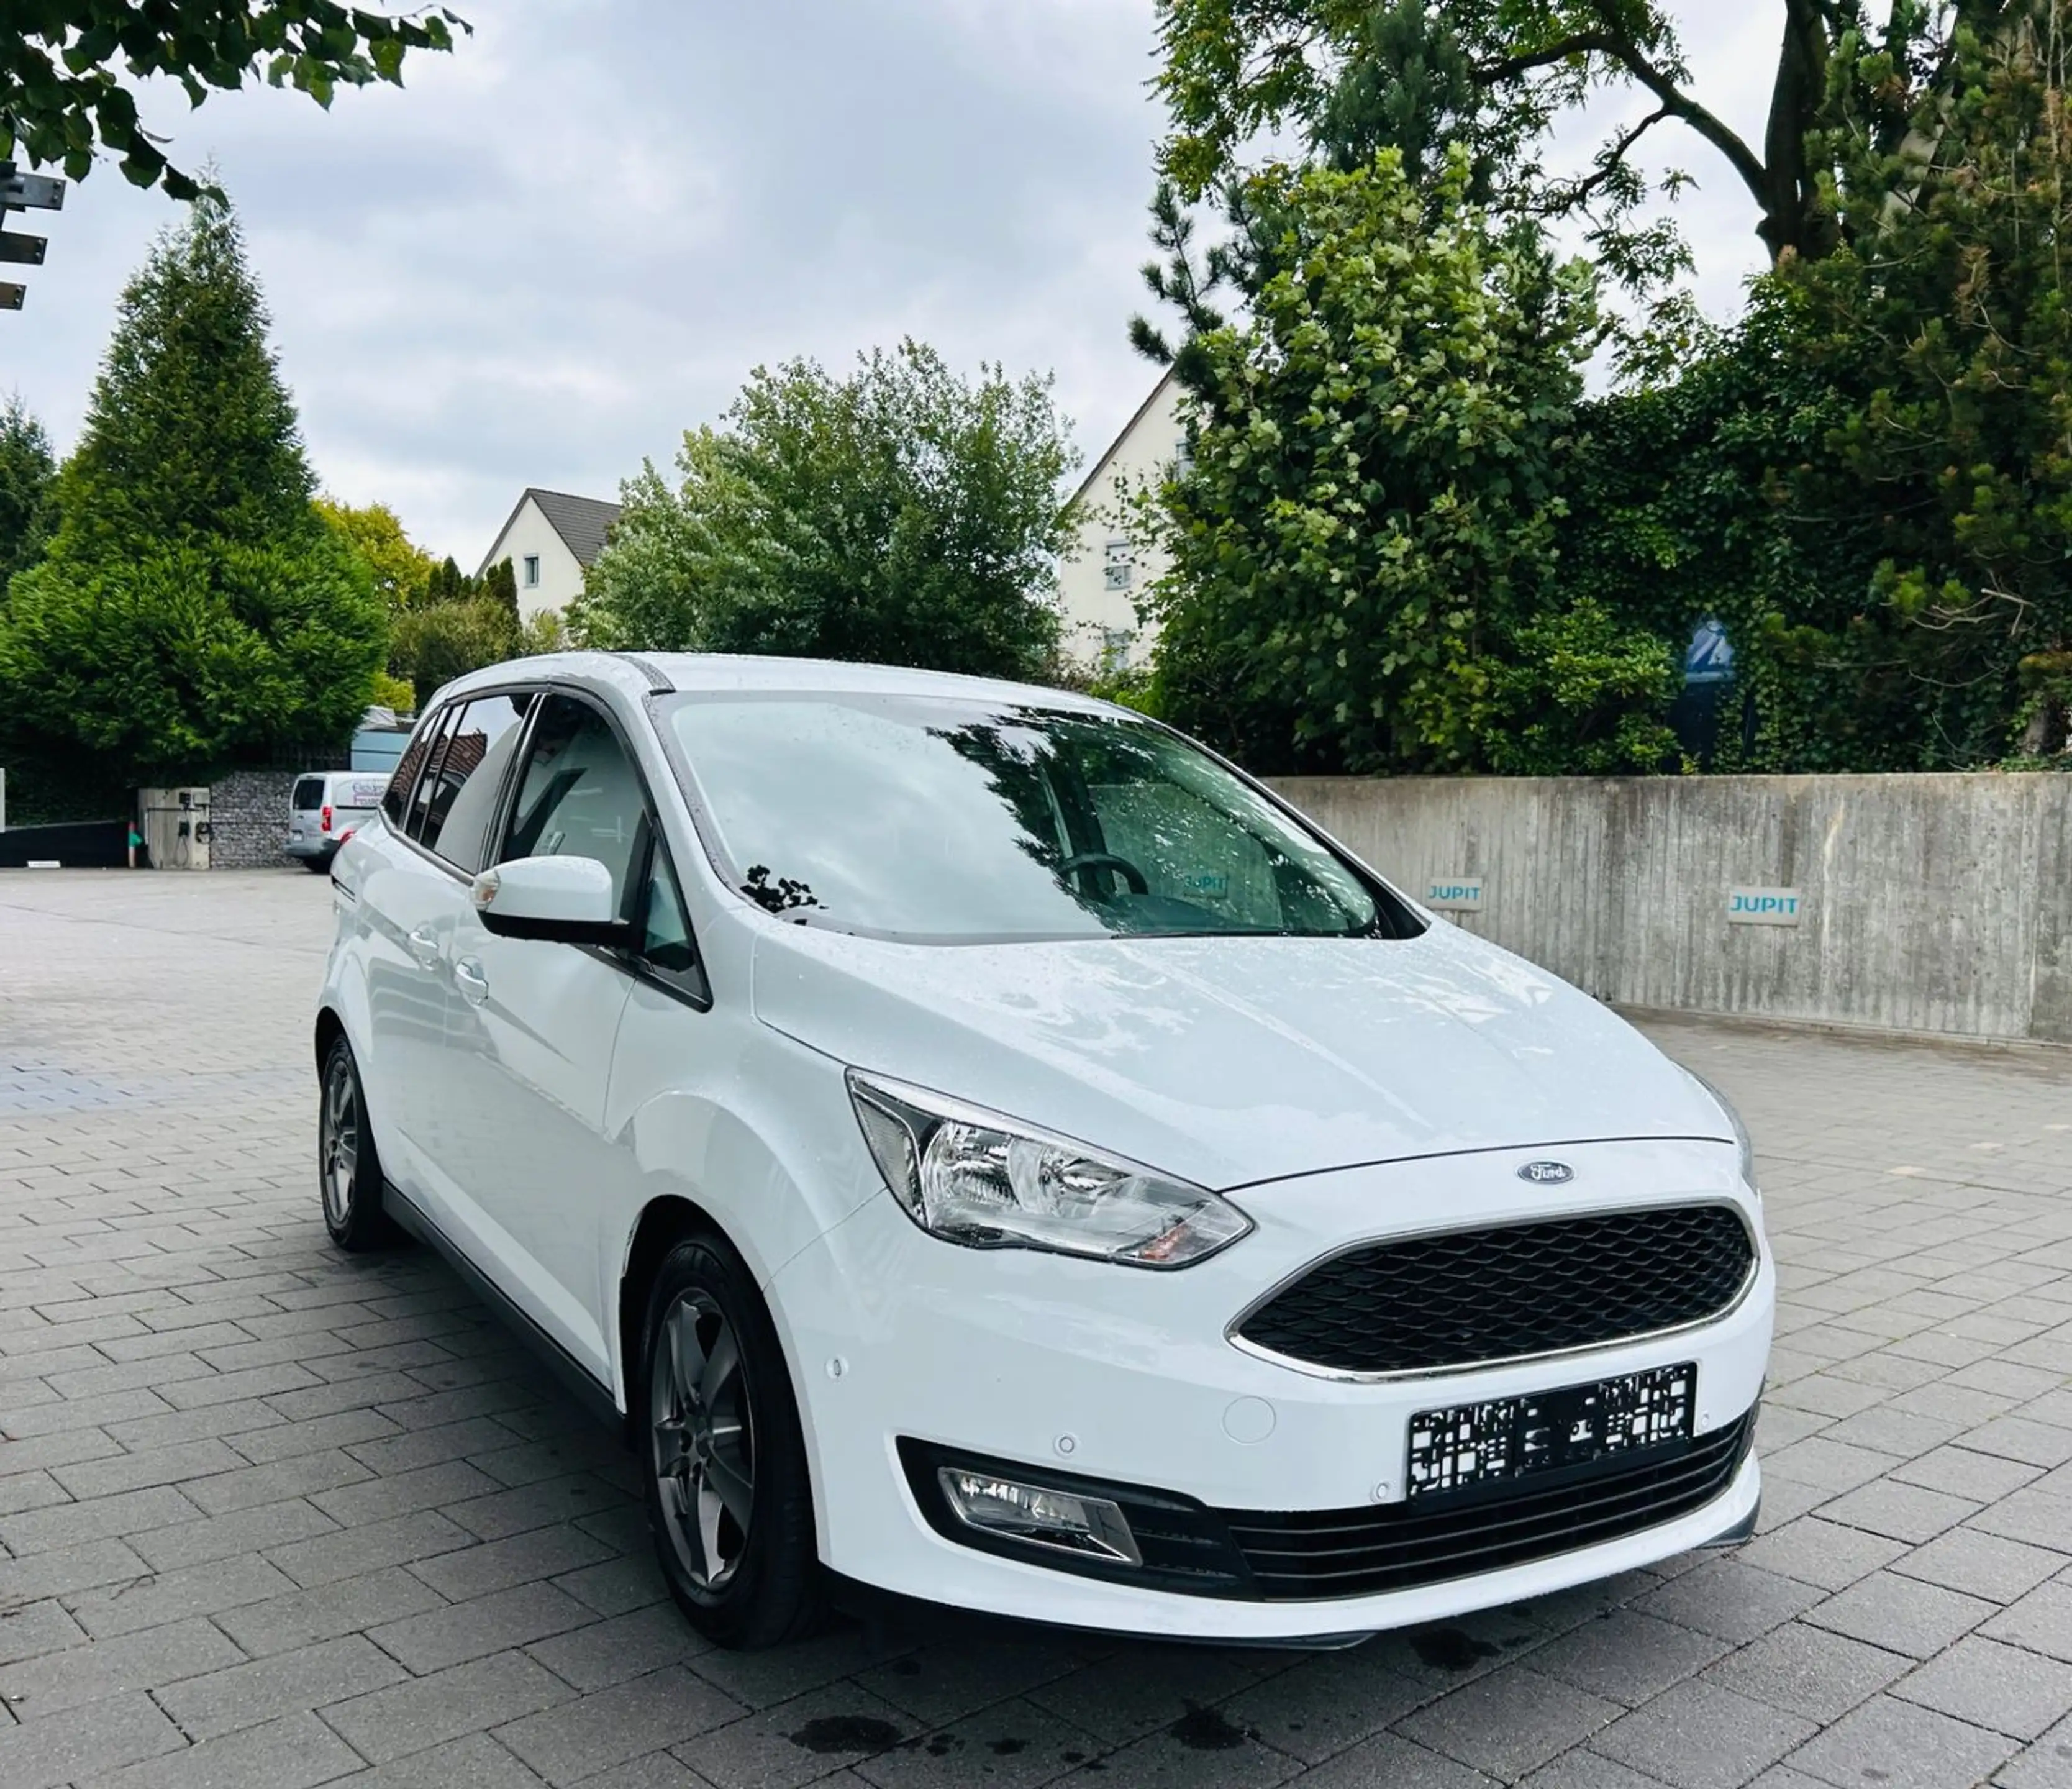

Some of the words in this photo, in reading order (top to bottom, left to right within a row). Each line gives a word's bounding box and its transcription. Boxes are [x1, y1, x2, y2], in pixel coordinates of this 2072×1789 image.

[1429, 885, 1481, 901] JUPIT
[1730, 896, 1797, 914] JUPIT
[1530, 1163, 1566, 1181] Ford
